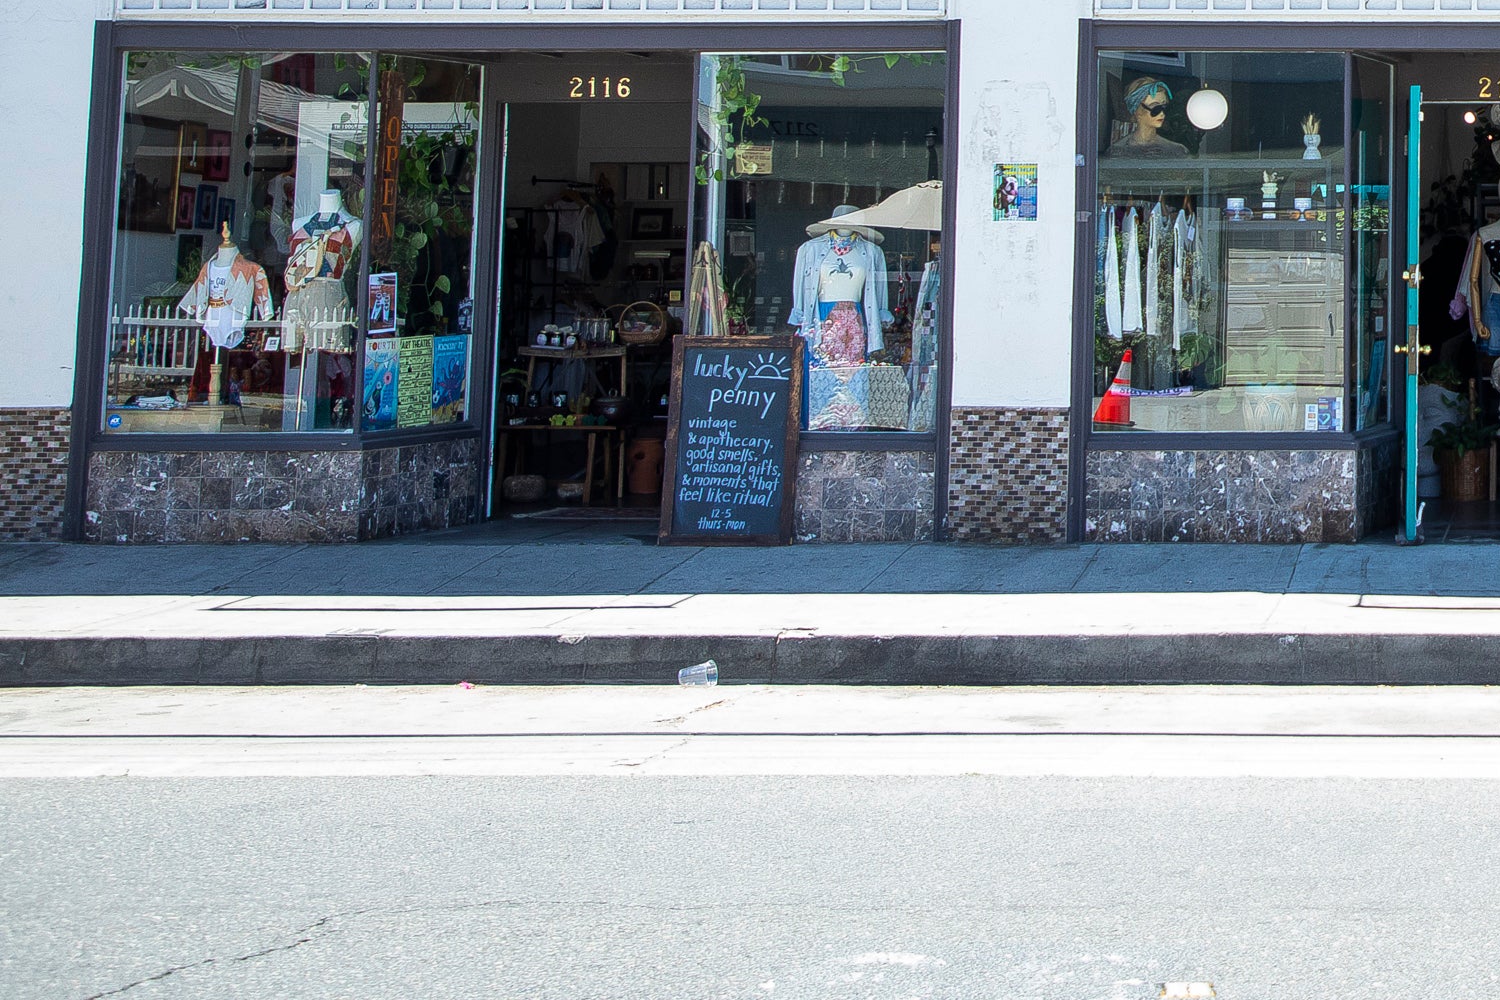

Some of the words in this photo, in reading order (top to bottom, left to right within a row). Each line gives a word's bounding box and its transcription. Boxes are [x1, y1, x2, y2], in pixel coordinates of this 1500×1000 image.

[569, 76, 631, 98] 2116
[368, 341, 396, 351] FOURTH
[412, 338, 432, 349] THEATRE
[694, 353, 748, 391] lucky
[708, 388, 776, 419] penny
[688, 416, 737, 435] vintage
[688, 431, 697, 445] &
[686, 446, 715, 466] good
[691, 459, 748, 475] artisanal
[748, 458, 781, 480] gifts,
[681, 473, 691, 486] &
[692, 474, 747, 489] moments
[751, 476, 780, 491] that
[678, 487, 703, 502] feel
[705, 488, 732, 503] like
[732, 489, 774, 508] ritual.
[697, 516, 746, 530] thurs-mon
[711, 508, 732, 519] 12-5
